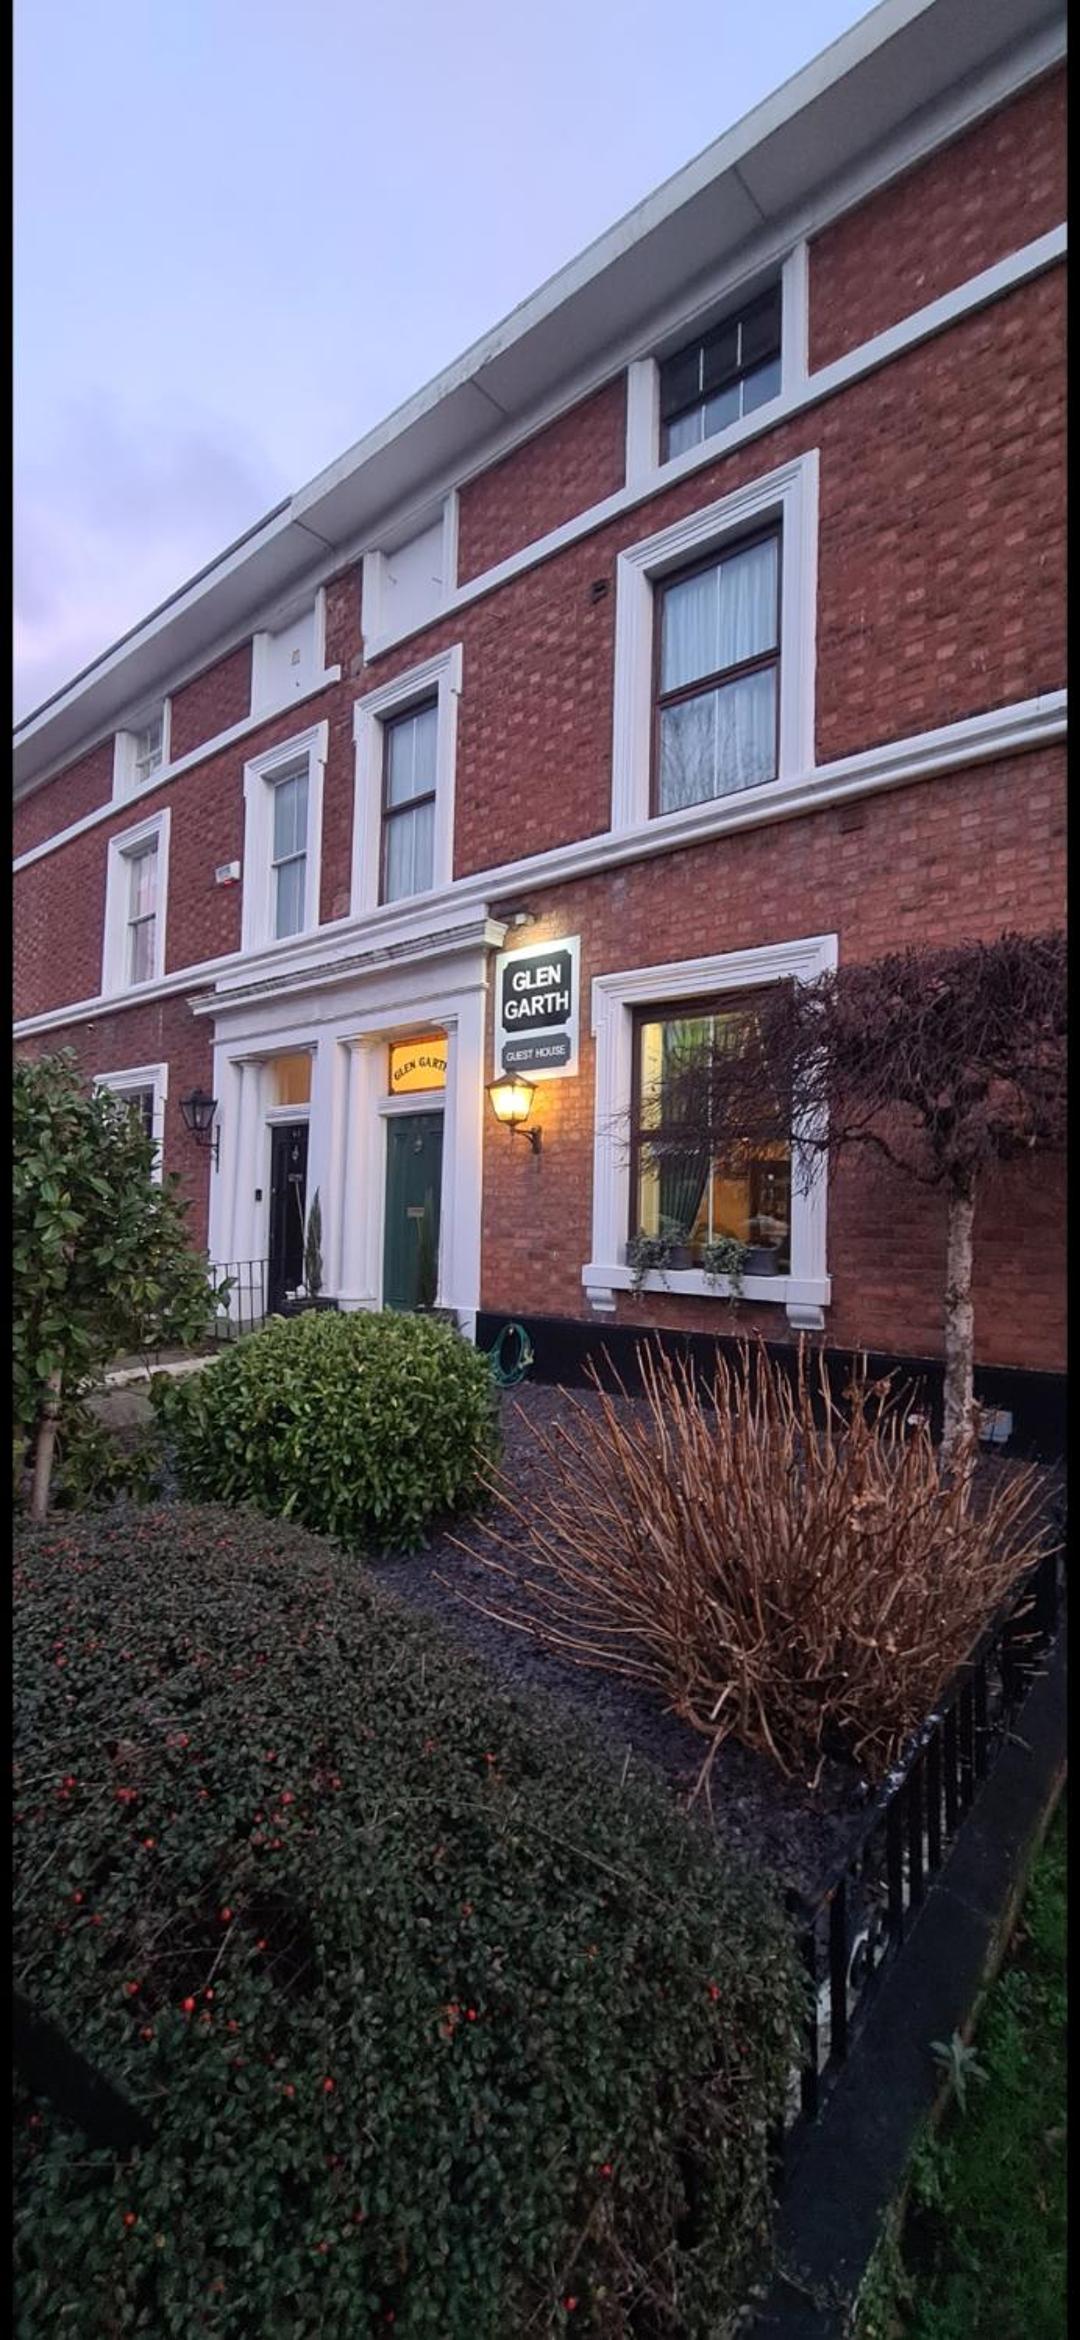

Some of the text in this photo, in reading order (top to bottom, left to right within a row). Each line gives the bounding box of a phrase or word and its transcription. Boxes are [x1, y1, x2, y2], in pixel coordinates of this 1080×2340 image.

[512, 963, 561, 992] GLEN
[504, 990, 569, 1020] GARTH
[506, 1044, 566, 1062] GUEST HOUSE
[394, 1060, 416, 1081] GLEN
